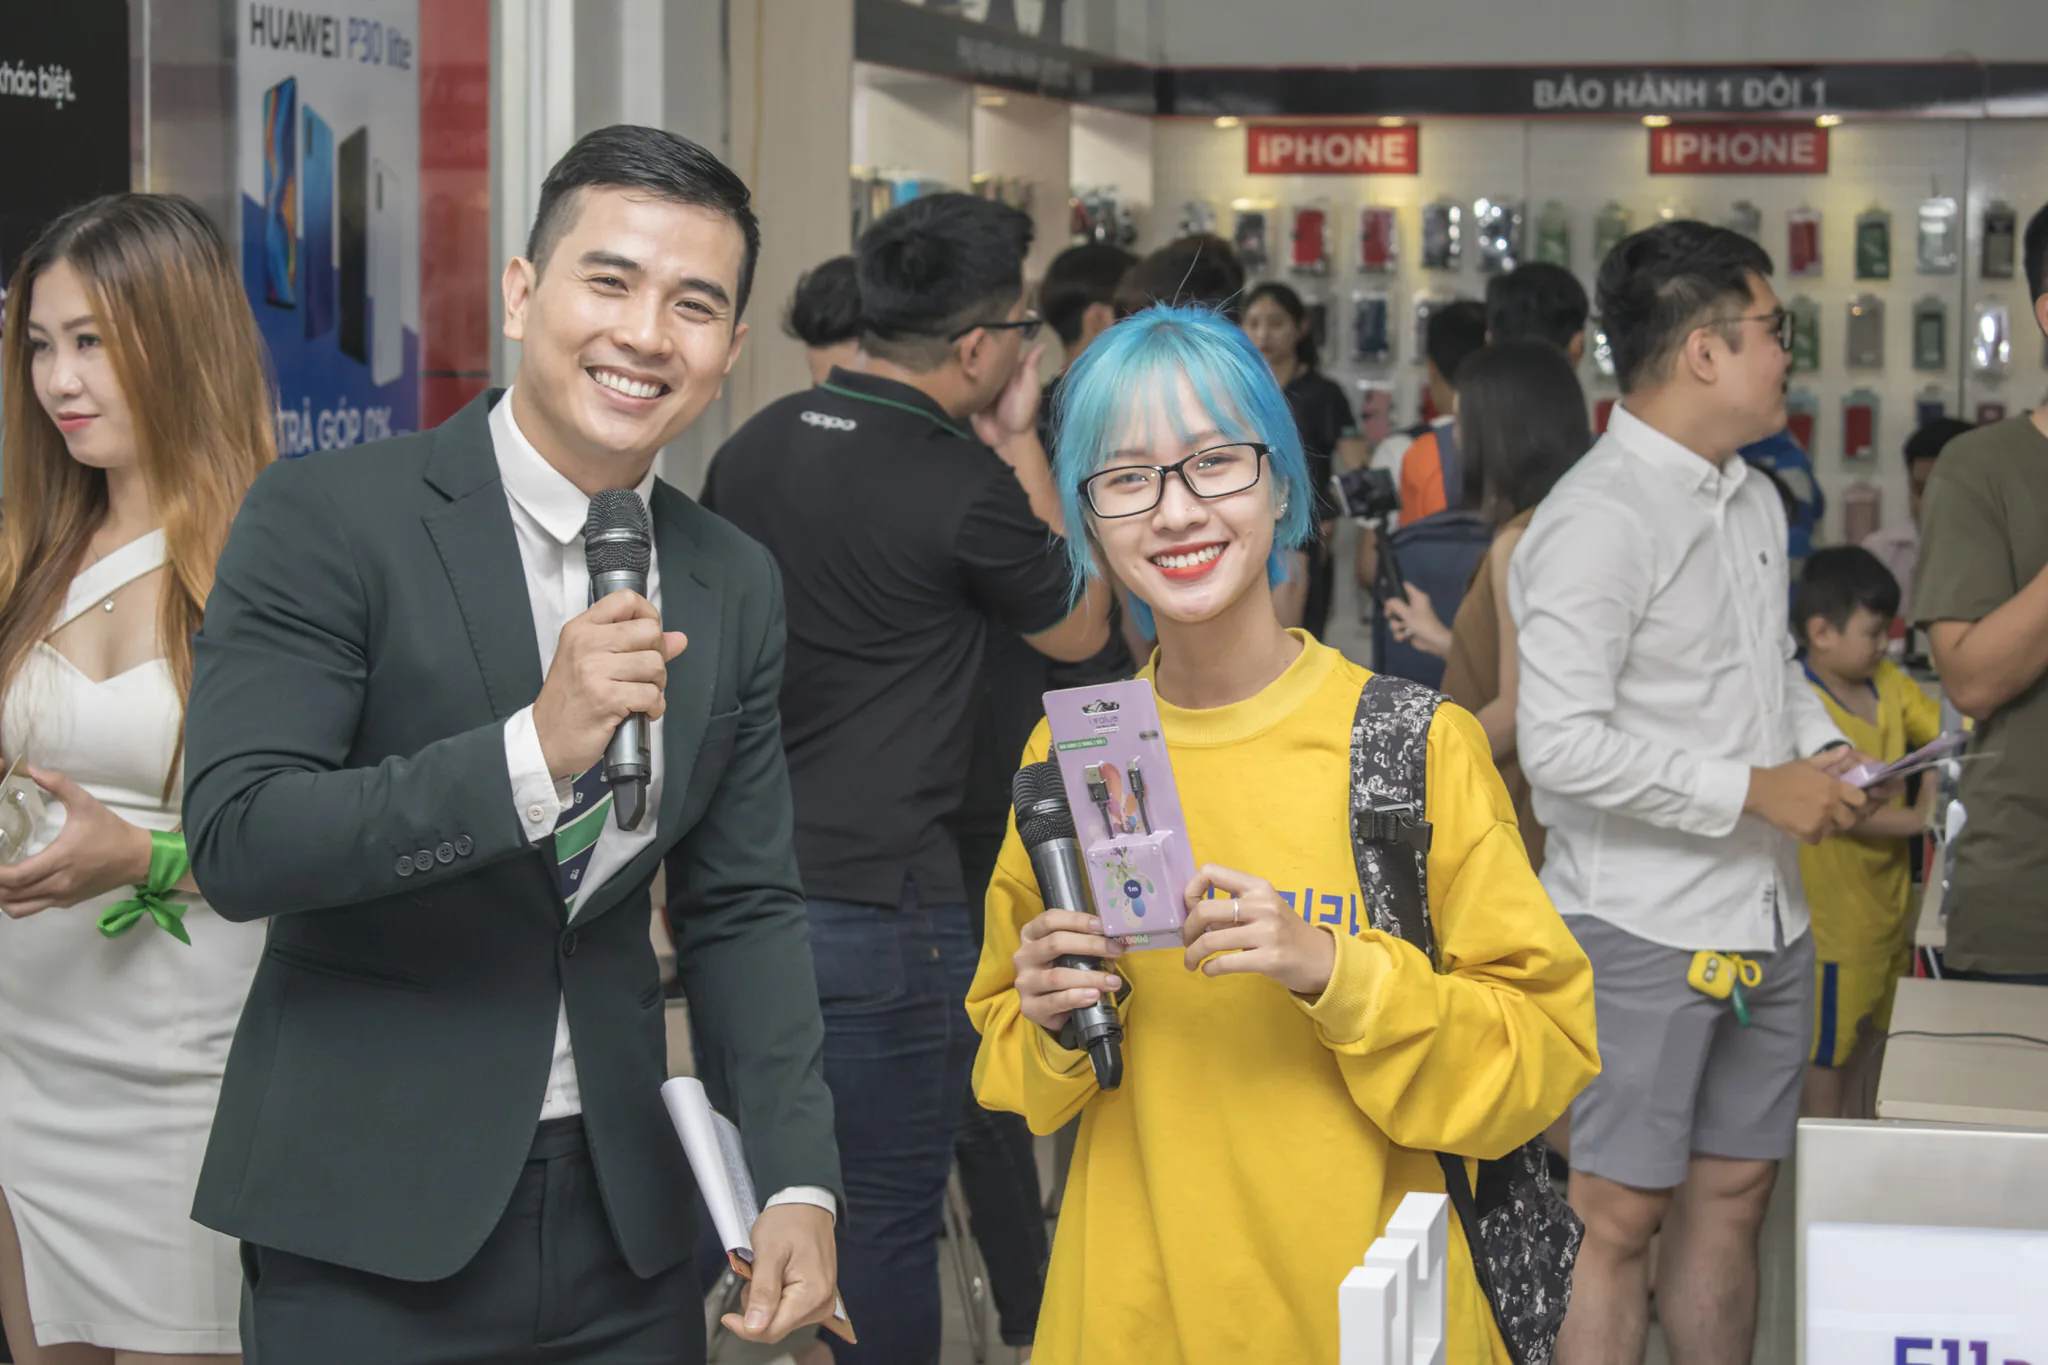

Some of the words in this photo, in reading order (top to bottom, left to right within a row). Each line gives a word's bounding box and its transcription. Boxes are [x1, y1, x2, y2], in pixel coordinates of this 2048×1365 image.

[250, 2, 340, 59] HUAWEI
[348, 15, 382, 65] P30
[1715, 80, 1731, 107] 1
[1810, 78, 1827, 107] 1
[317, 395, 361, 450] GÓP
[800, 411, 858, 431] oppo
